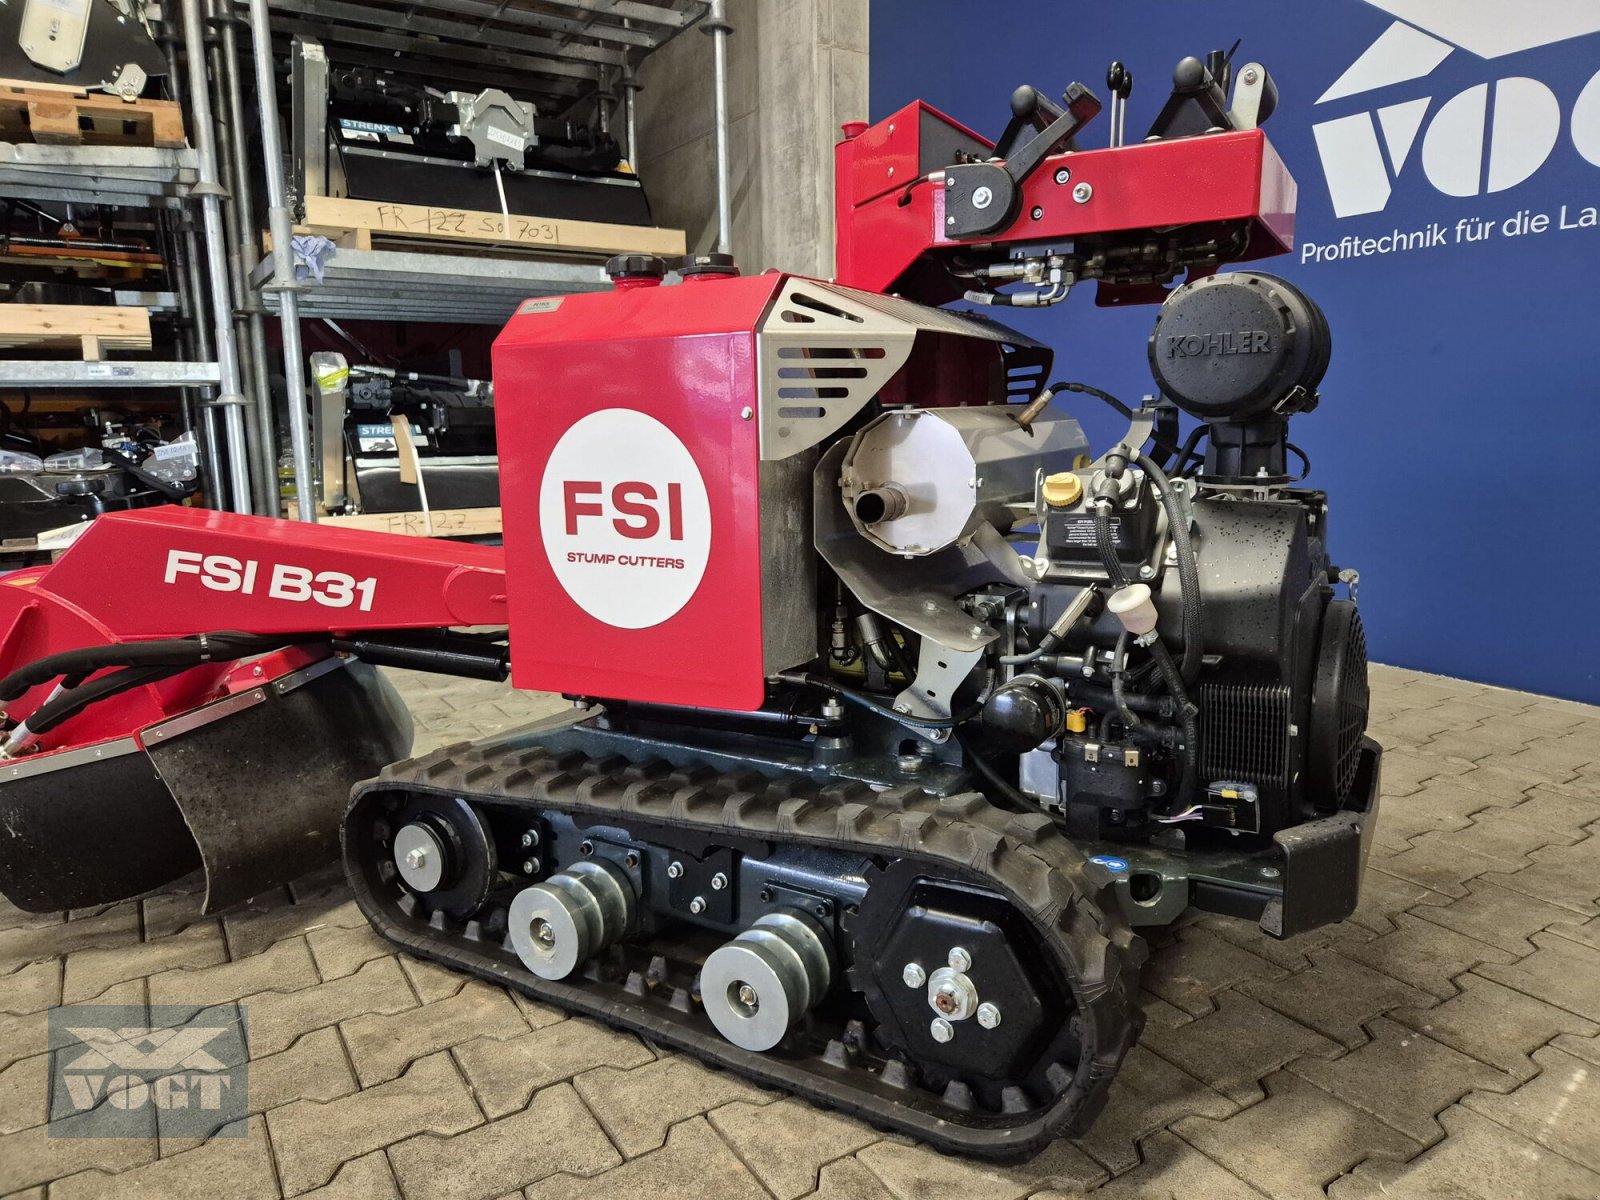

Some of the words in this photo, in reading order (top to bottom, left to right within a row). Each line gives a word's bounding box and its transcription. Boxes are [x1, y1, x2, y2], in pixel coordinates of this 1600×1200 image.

[1301, 224, 1447, 264] Profitechnik
[1455, 217, 1496, 243] für
[1502, 210, 1550, 237] die
[1559, 204, 1600, 230] La
[1168, 330, 1270, 358] KOHLER
[361, 426, 395, 435] STRE
[563, 481, 684, 541] FSI
[164, 549, 258, 595] FSI
[268, 563, 378, 612] B31
[567, 552, 615, 564] STUMP
[618, 555, 685, 569] CUTTERS
